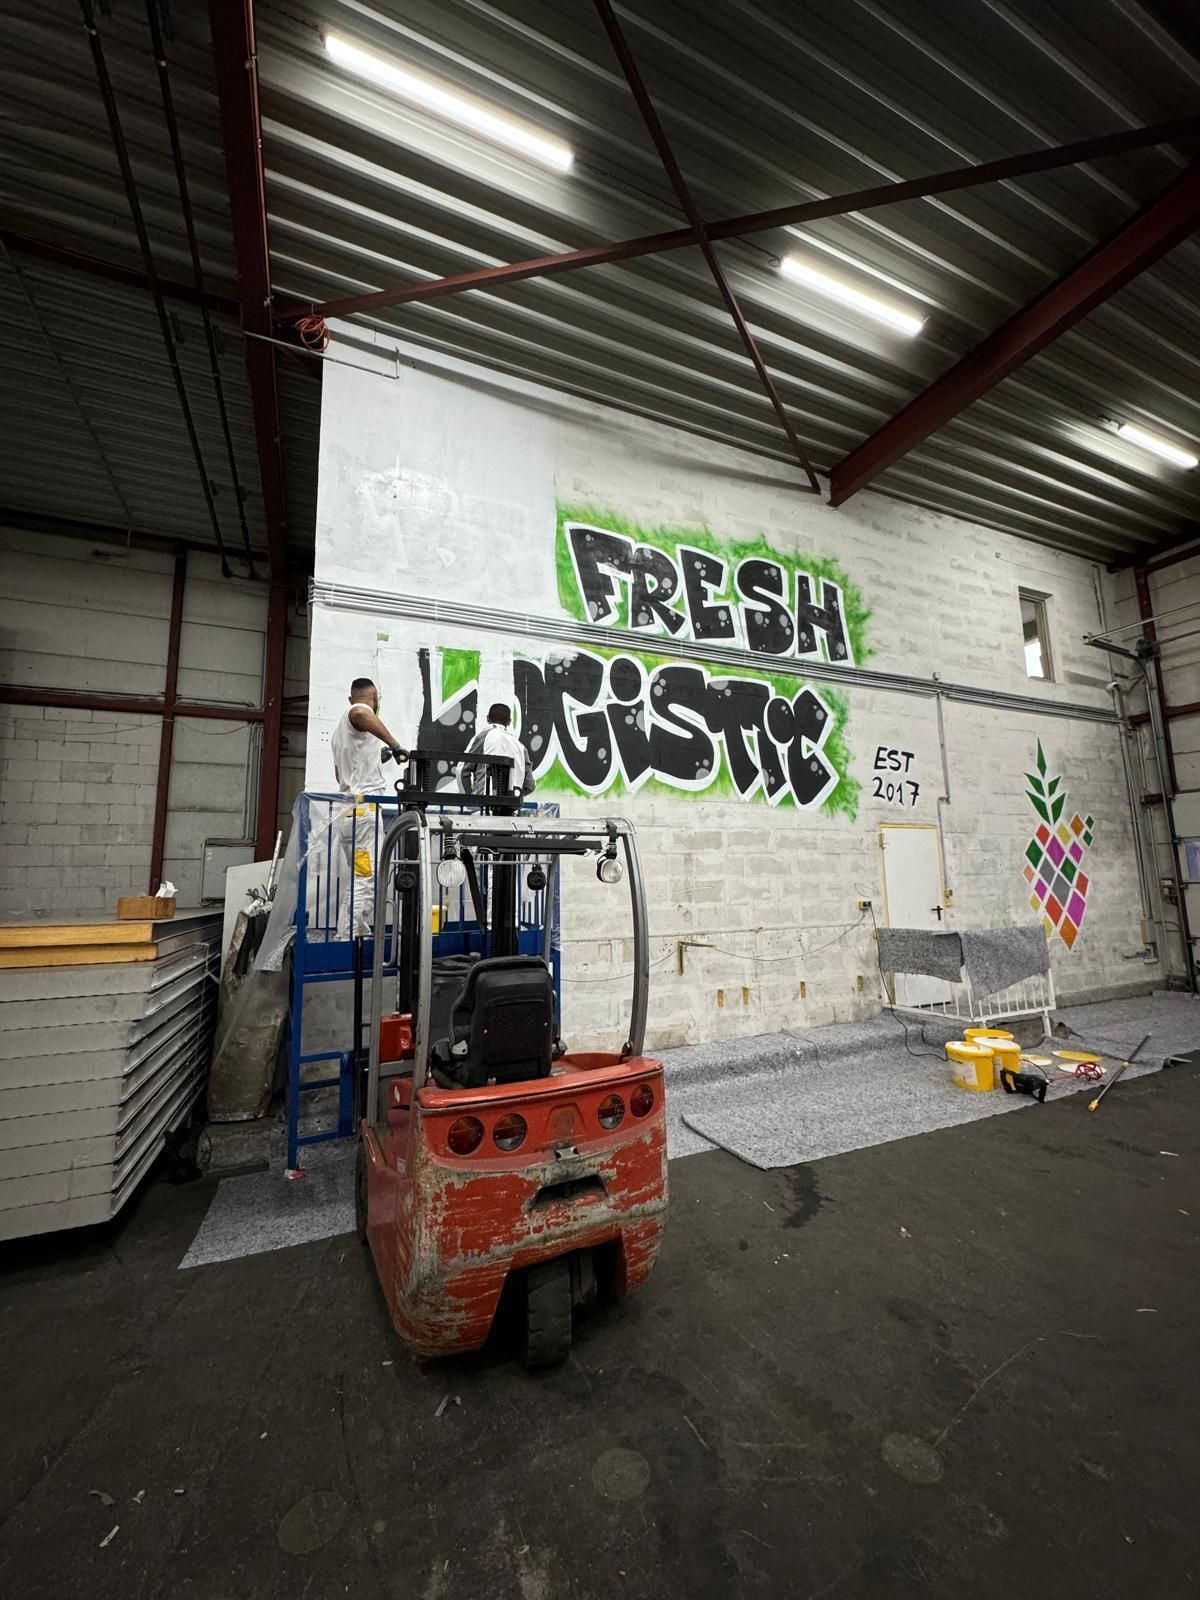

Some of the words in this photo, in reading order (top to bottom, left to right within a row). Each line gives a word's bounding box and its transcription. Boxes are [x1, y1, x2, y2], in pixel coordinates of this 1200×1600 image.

[565, 521, 855, 667] FRESH
[873, 746, 915, 773] EST
[872, 776, 920, 806] 2017
